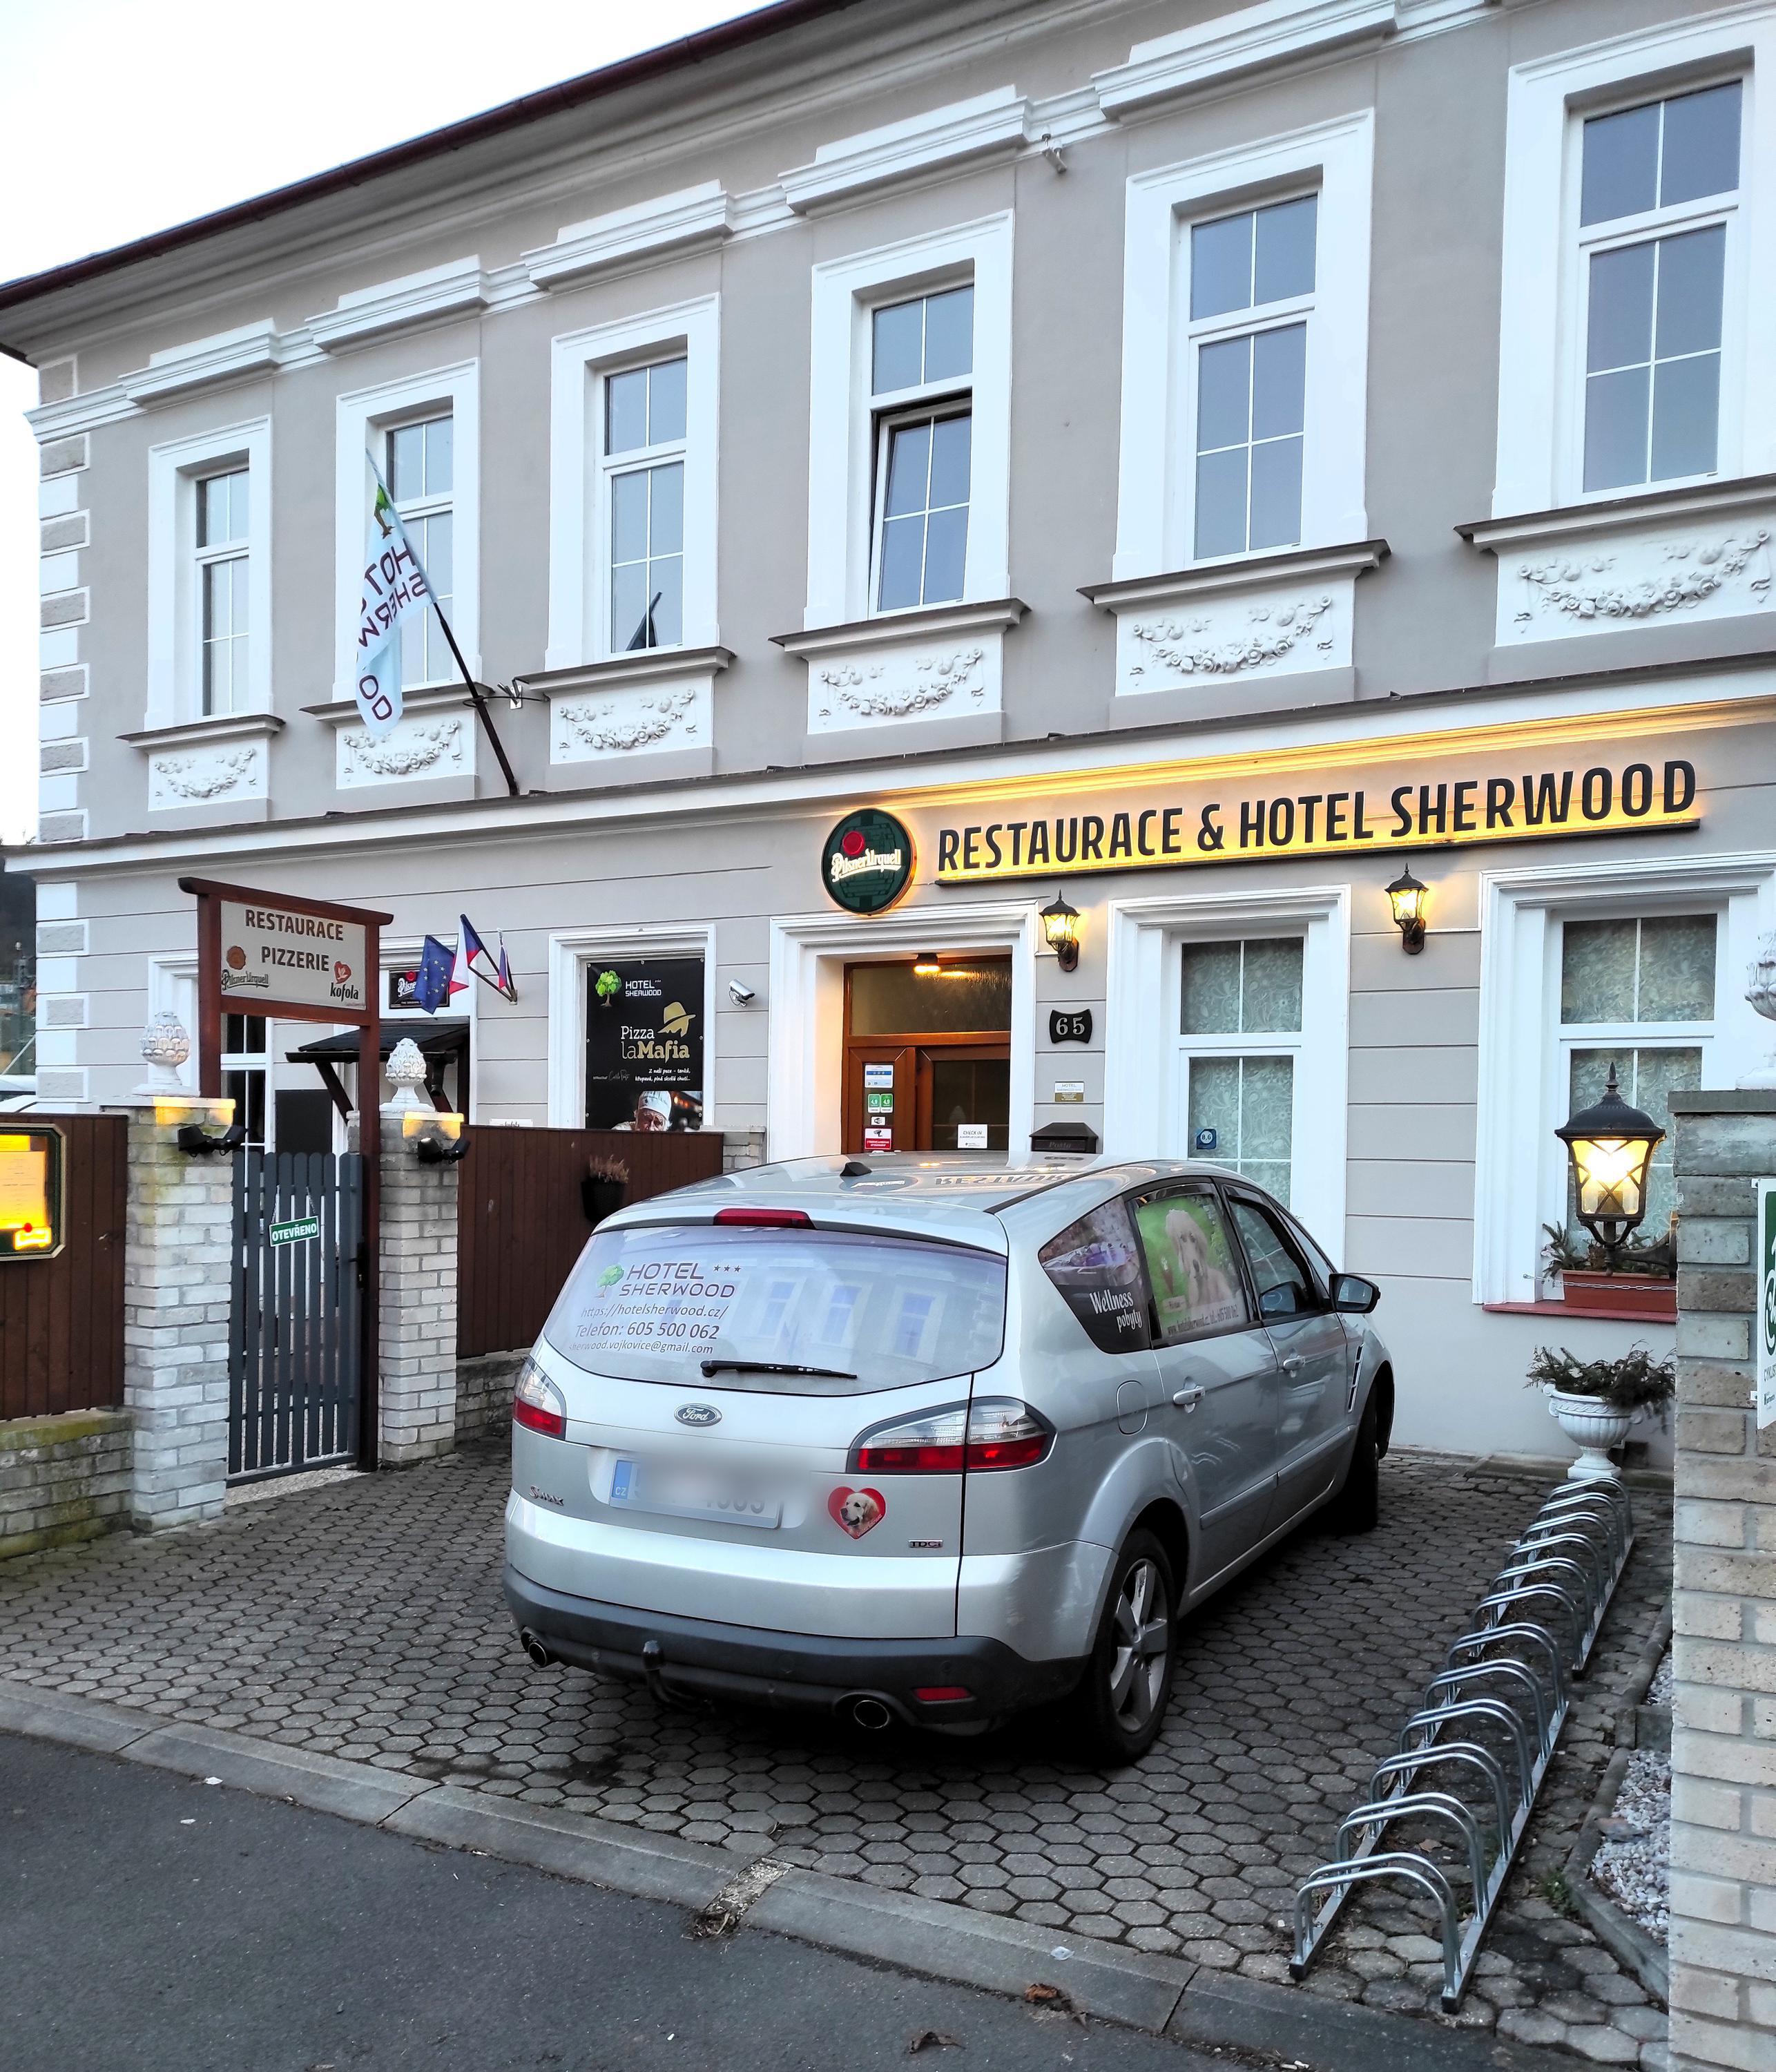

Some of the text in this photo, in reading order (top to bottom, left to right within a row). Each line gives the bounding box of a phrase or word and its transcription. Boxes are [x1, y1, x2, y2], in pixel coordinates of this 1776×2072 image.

[938, 760, 1696, 872] RESTAURACE & HOTEL SHERWOOD
[831, 848, 902, 883] Pilsner Urquell
[245, 909, 344, 941] RESTAURACE
[261, 946, 329, 972] PIZZERIE
[330, 982, 359, 1002] kofola
[626, 980, 655, 989] HOTEL
[621, 1026, 655, 1039] Pizza
[1055, 1017, 1085, 1035] 65
[272, 1223, 317, 1242] OTEVŘENO
[626, 1263, 704, 1280] HOTEL
[619, 1283, 735, 1298] SHERWOOD
[1089, 1289, 1133, 1314] Wellness
[581, 1304, 729, 1320] https://hotelsherwood.cz/
[1117, 1309, 1142, 1333] pobyty
[575, 1322, 720, 1340] Telefon: 605 500 062
[682, 1408, 710, 1421] Ford
[615, 1486, 626, 1497] CZ
